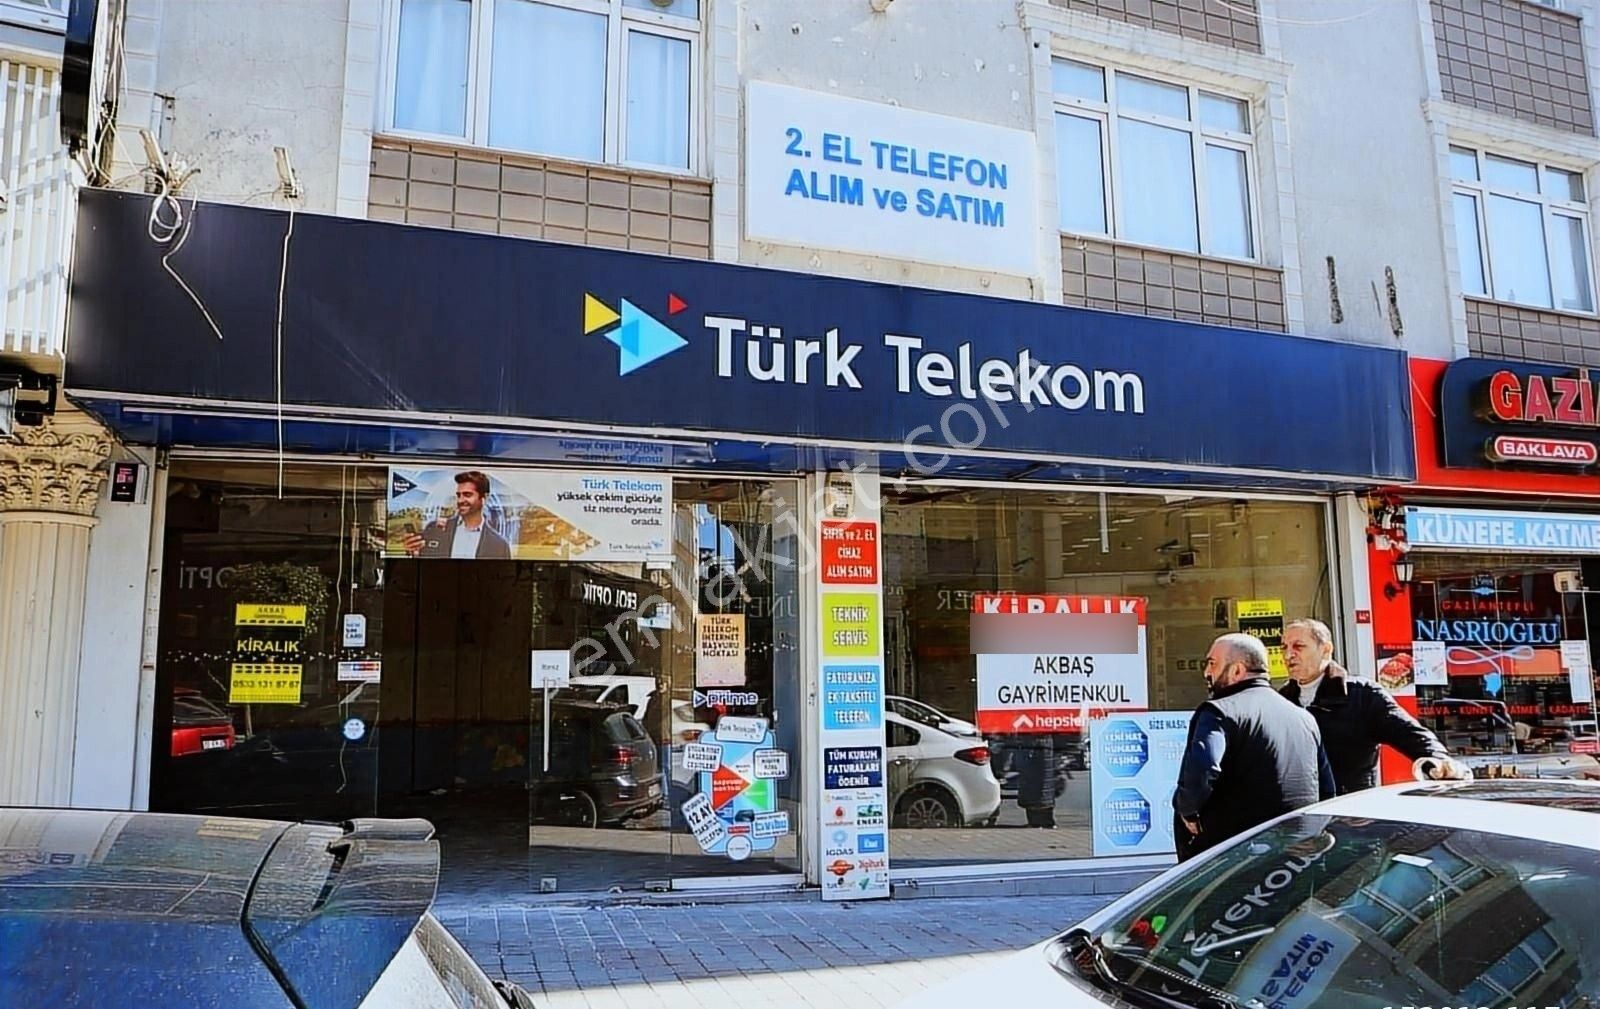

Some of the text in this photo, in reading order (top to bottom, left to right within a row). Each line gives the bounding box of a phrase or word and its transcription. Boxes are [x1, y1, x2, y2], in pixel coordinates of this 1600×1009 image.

[785, 127, 1008, 190] 2. EL TELEFON
[784, 168, 1004, 227] ALIM ve SATIM
[704, 315, 1144, 414] Türk Telekom
[1490, 367, 1600, 427] GAZİ
[1503, 441, 1588, 460] BAKLAVA
[582, 479, 662, 492] Türk Telekom
[557, 492, 663, 506] yüksek çekim gücüyle
[598, 505, 662, 517] neredeyseniz
[631, 516, 663, 527] orada.
[865, 529, 875, 541] EL
[838, 544, 861, 559] CİHAZ
[827, 565, 873, 578] ALIM SATIM
[832, 603, 869, 622] TEKNİK
[703, 625, 739, 633] TELEKOM
[833, 627, 868, 646] SERVİS
[1416, 616, 1559, 643] NASRİOĞLU
[237, 637, 299, 653] KİRALIK
[1033, 655, 1094, 677] AKBAŞ
[708, 691, 758, 706] prime
[998, 681, 1130, 704] GAYRİMENKUL
[834, 710, 870, 723] TELEFON
[829, 748, 878, 760] TÜM KURUM
[828, 763, 880, 775] FATURALARI
[838, 773, 869, 787] ÖDENİR
[689, 812, 701, 826] 12
[700, 803, 712, 820] AY
